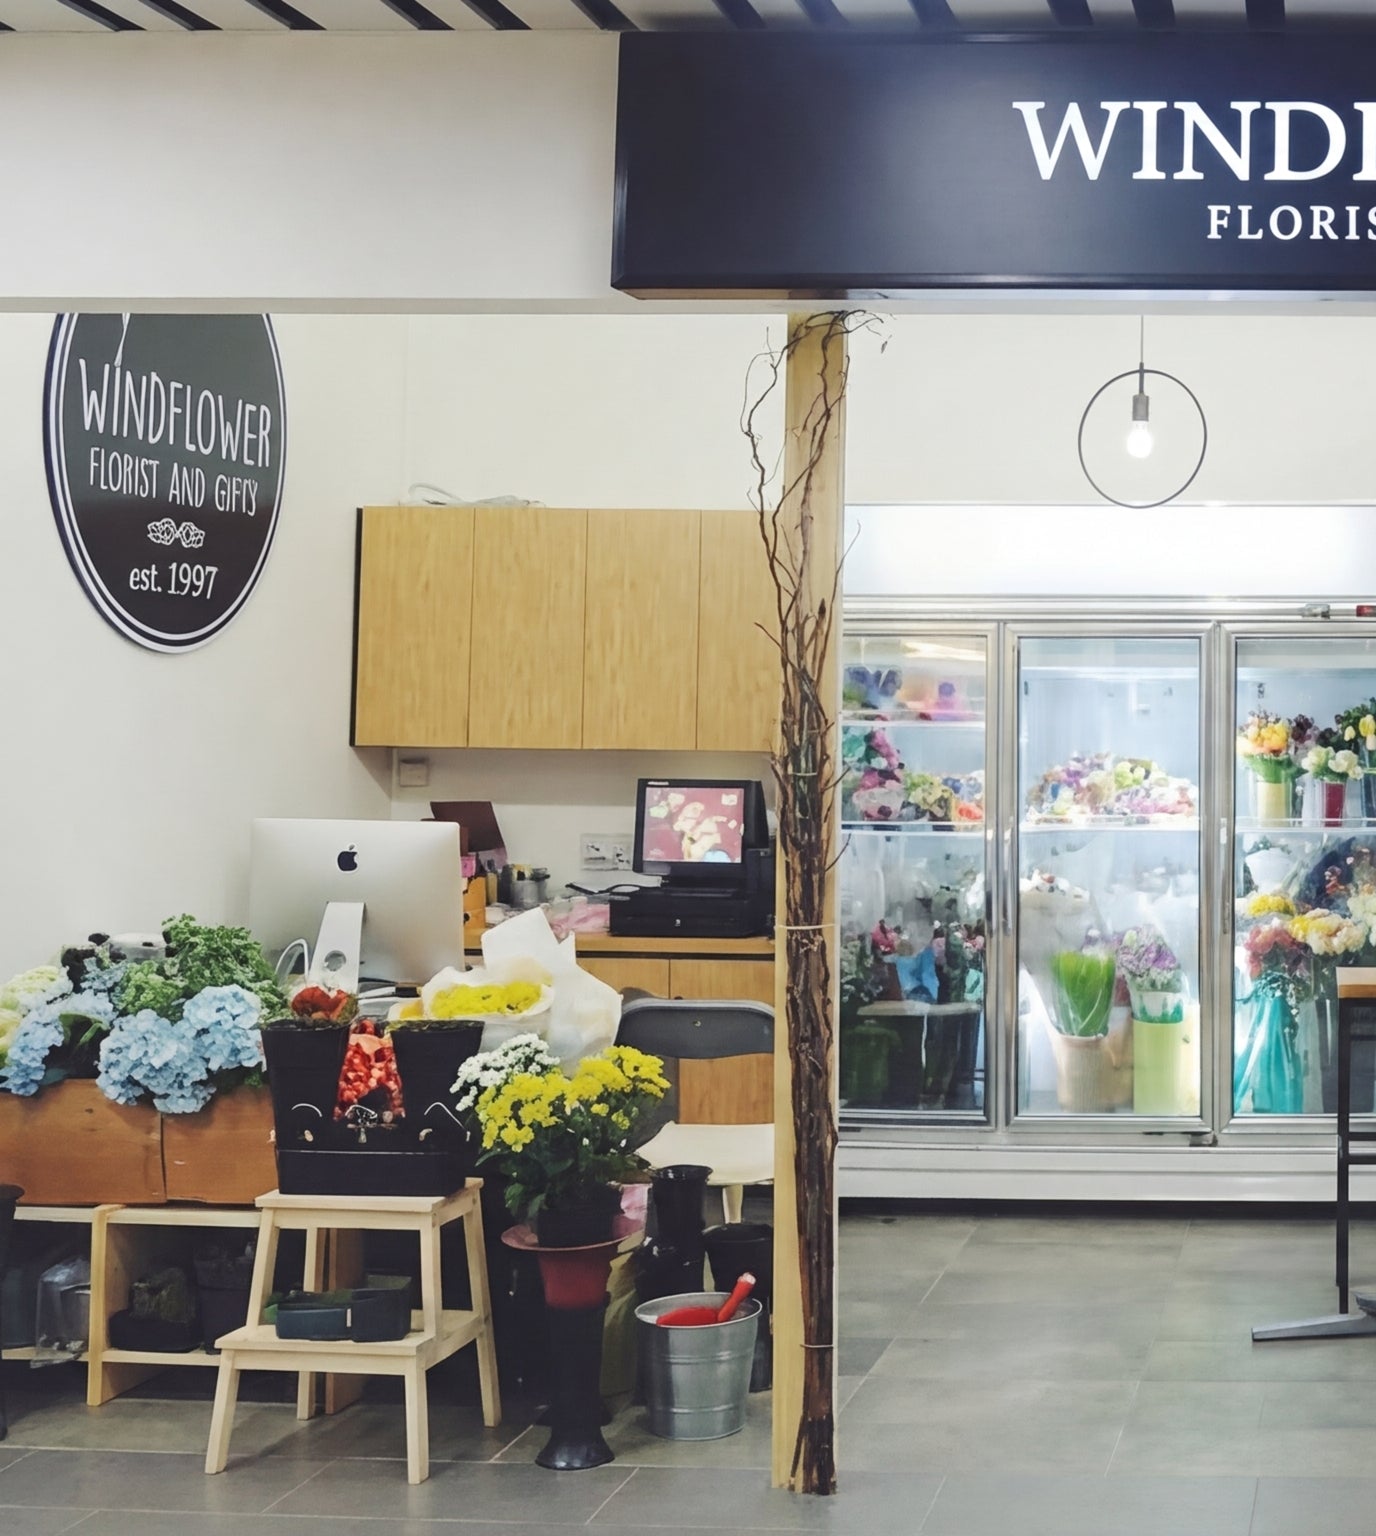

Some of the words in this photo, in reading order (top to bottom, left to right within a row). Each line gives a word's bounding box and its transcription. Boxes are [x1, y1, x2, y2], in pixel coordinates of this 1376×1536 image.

[79, 358, 271, 467] WINDFLOWER
[90, 447, 160, 499] FLORIST
[169, 462, 206, 508] AND
[129, 564, 162, 592] est.
[167, 562, 218, 599] 1997
